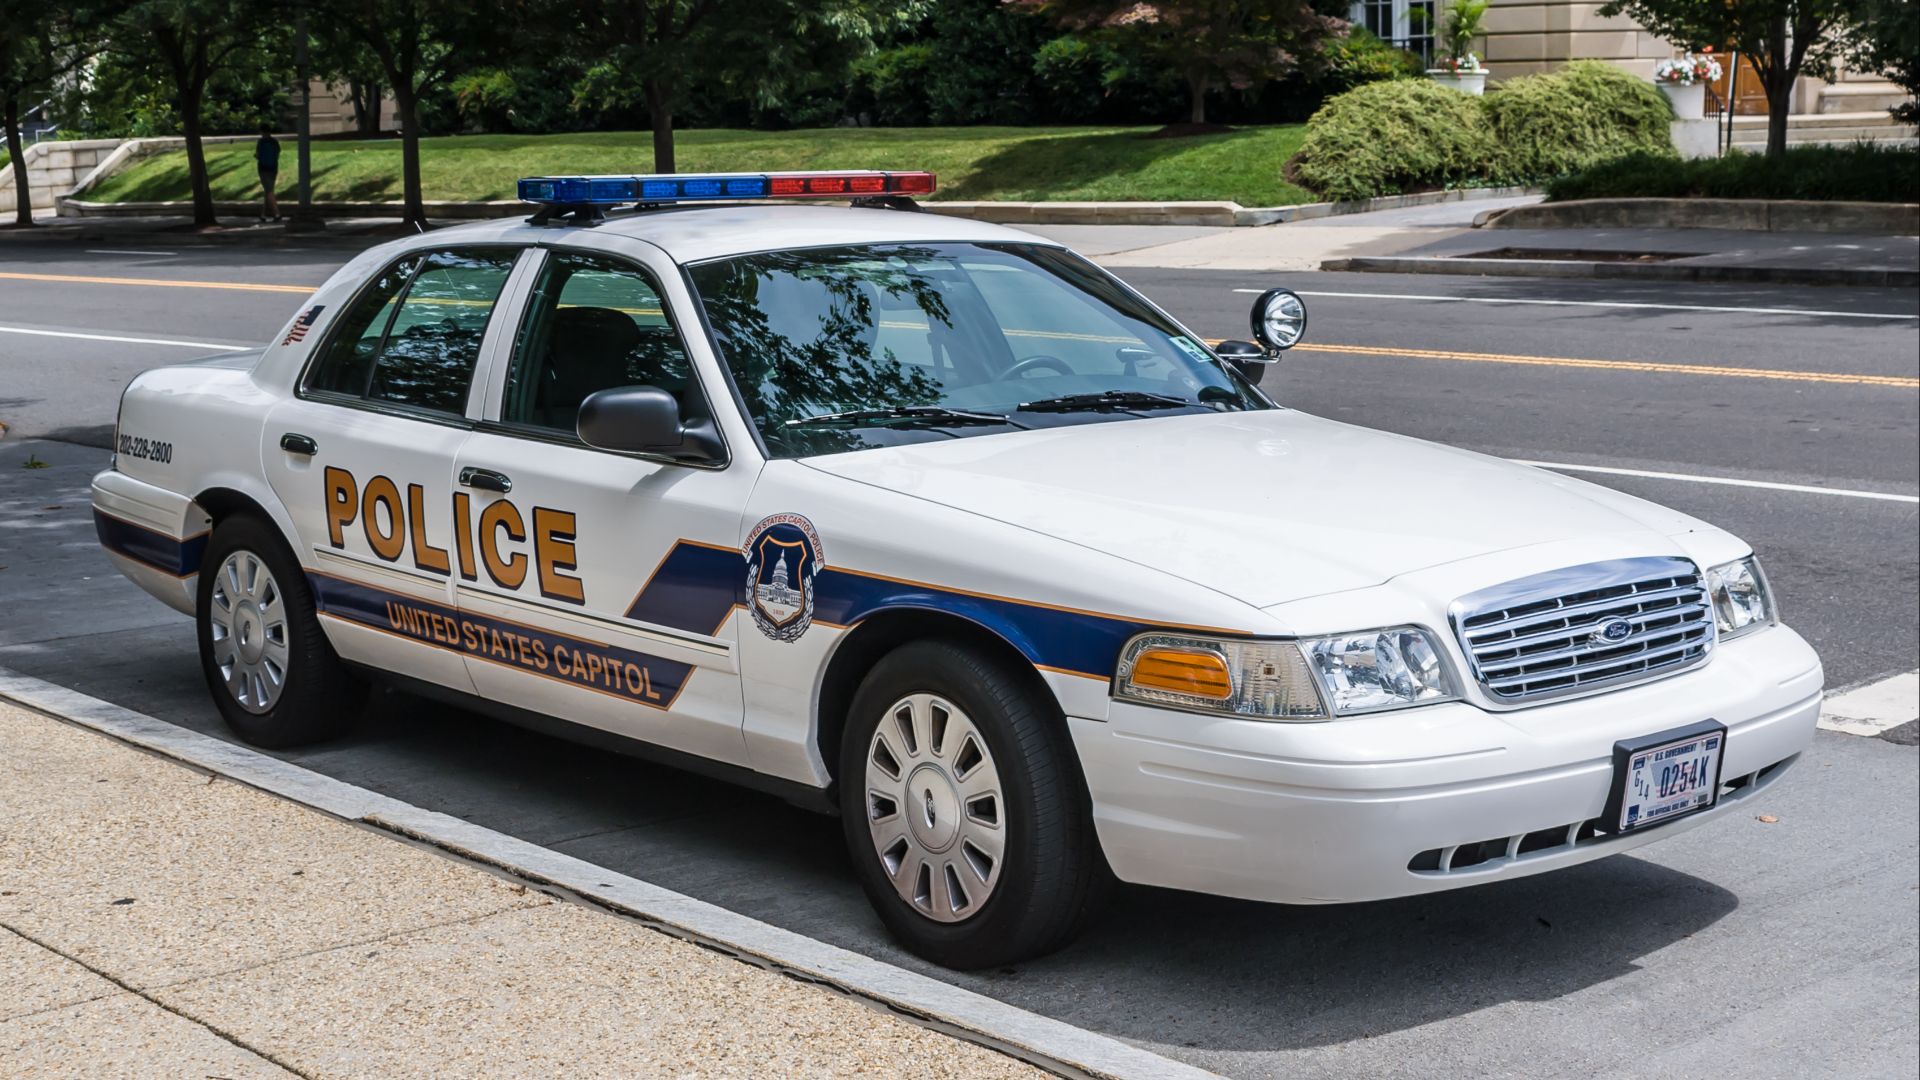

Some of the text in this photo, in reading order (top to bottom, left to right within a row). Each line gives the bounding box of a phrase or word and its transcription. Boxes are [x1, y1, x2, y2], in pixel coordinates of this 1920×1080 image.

[120, 434, 172, 464] 202-228-2800
[324, 465, 585, 606] POLICE
[742, 515, 824, 565] UNITED STATES CAPITOL POLICE
[386, 601, 660, 700] UNITED STATES CAPITOL
[1665, 743, 1697, 759] GOVERNMENT
[1660, 756, 1710, 798] 0254K
